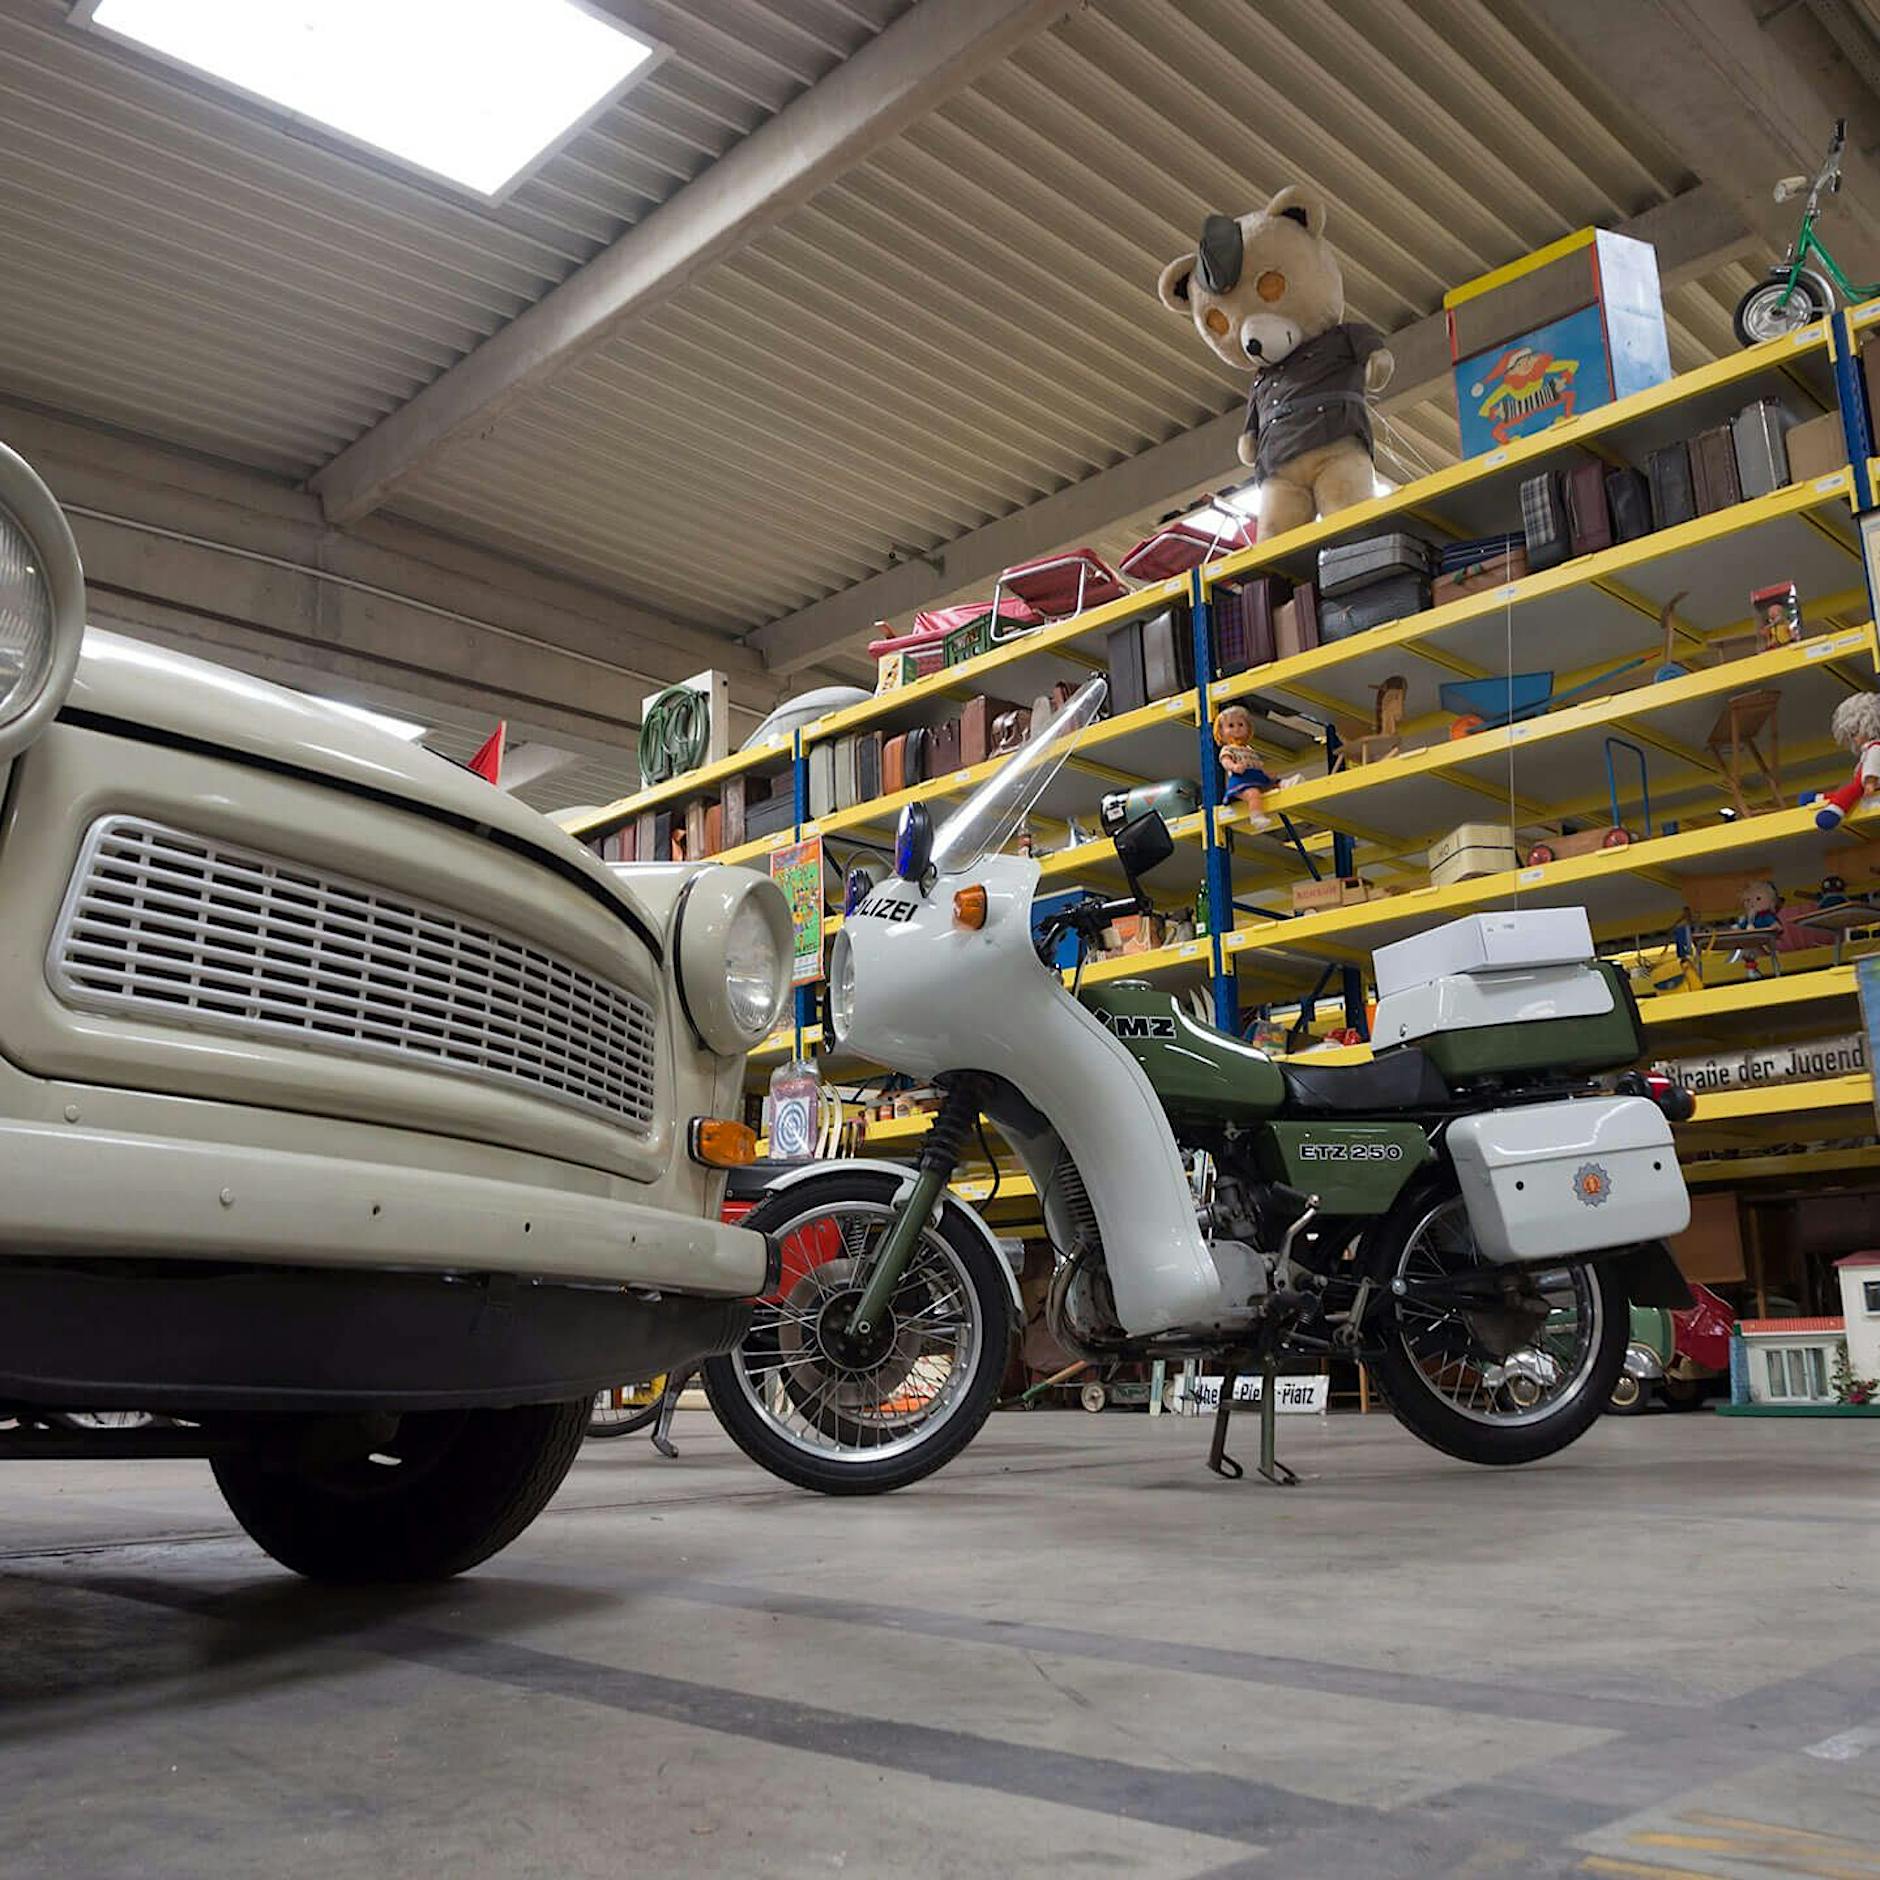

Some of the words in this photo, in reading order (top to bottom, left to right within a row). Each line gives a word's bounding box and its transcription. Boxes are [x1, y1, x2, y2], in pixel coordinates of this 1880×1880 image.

[1114, 1015, 1177, 1039] MZ
[1738, 1050, 1775, 1081] der
[1785, 1036, 1864, 1076] Jugend
[1300, 1144, 1348, 1160] ETZ
[1350, 1144, 1403, 1160] 250
